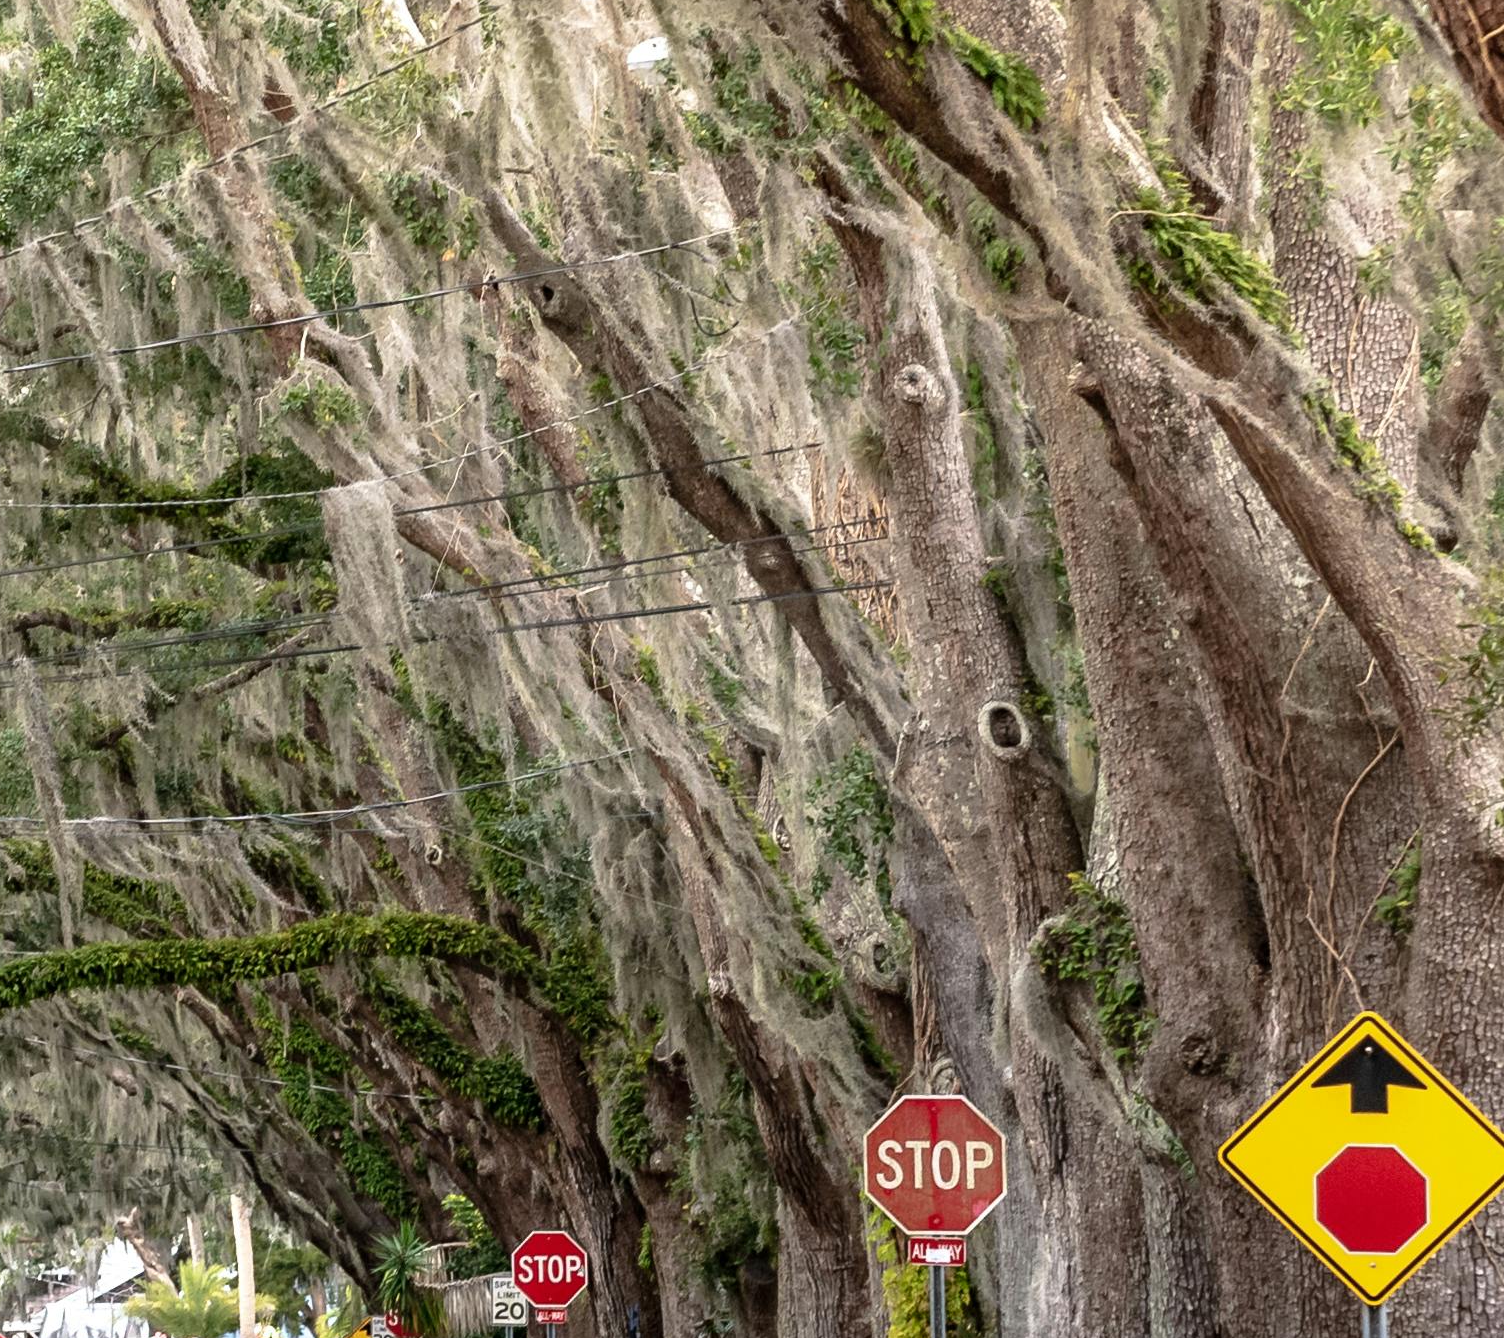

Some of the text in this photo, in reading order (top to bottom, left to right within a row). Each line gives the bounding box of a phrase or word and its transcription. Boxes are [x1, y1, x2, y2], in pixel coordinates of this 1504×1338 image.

[876, 1139, 994, 1190] STOP
[518, 1255, 581, 1283] STOP
[495, 1281, 515, 1289] SPE
[494, 1302, 524, 1320] 20
